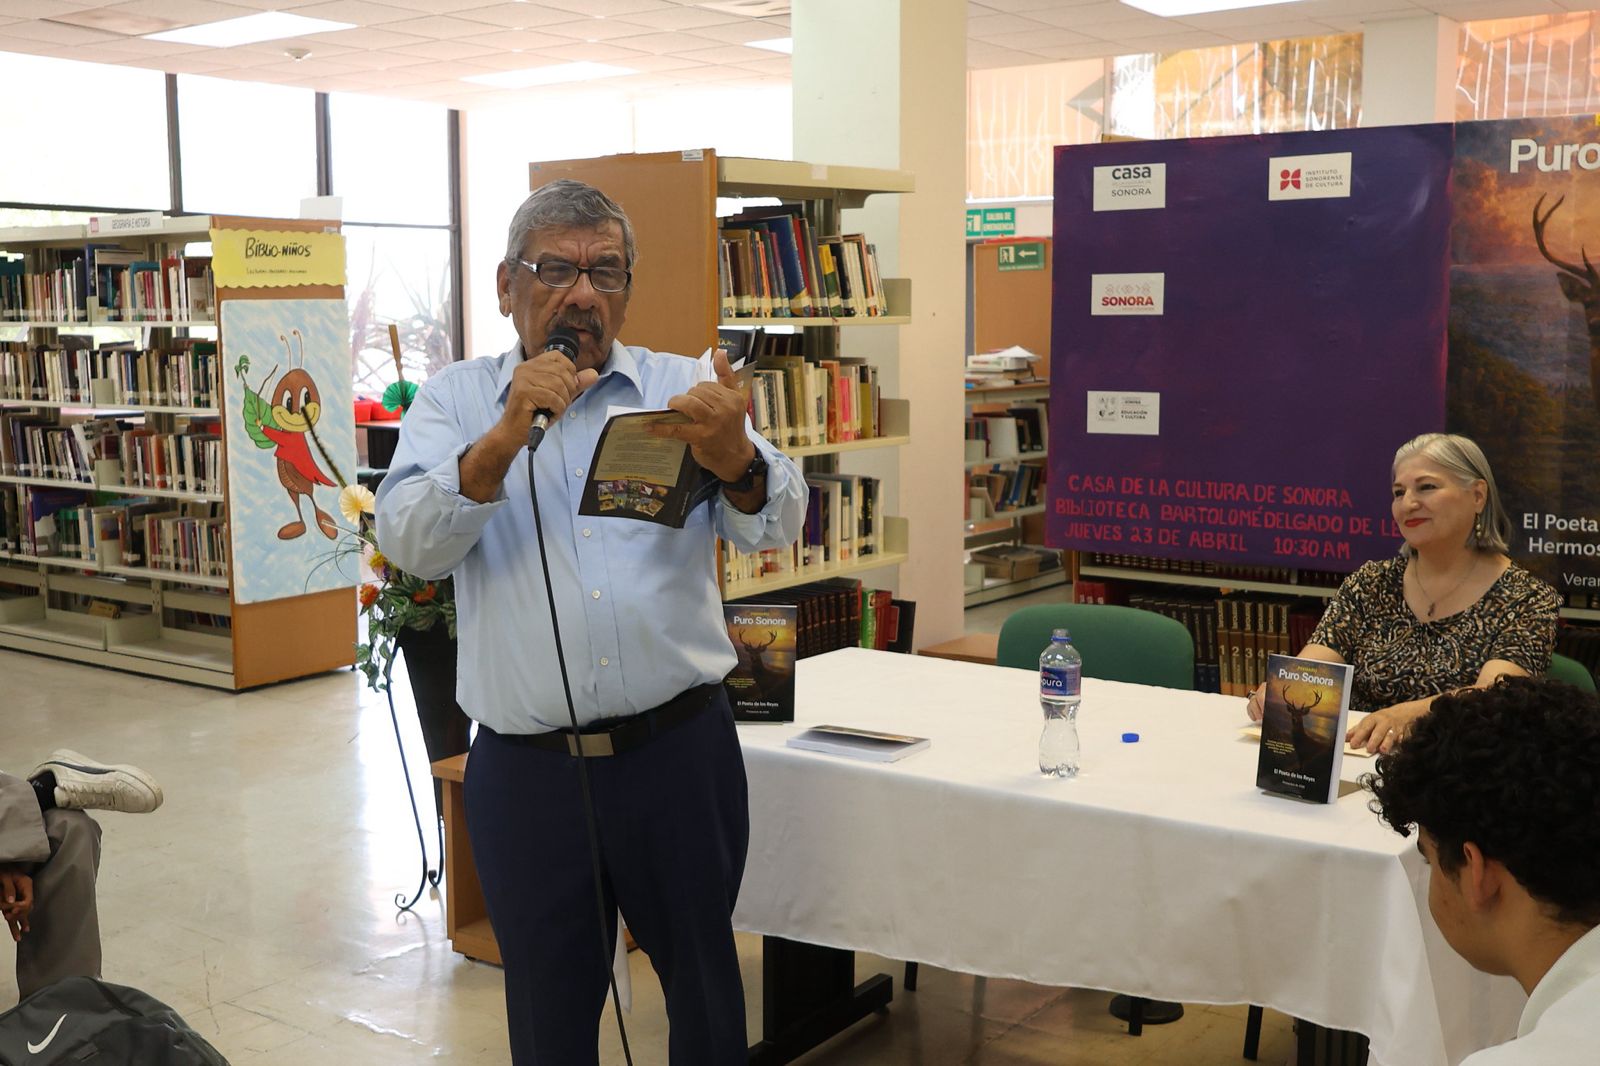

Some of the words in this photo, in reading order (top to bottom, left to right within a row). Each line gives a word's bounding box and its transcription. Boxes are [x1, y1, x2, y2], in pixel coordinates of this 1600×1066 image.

[1510, 138, 1600, 173] Puro
[1112, 166, 1151, 180] casa
[1112, 188, 1151, 197] SONORA
[1102, 296, 1153, 306] SONORA
[1068, 474, 1115, 493] CASA
[1121, 477, 1143, 495] DE
[1150, 479, 1169, 497] LA
[1176, 480, 1250, 501] CULTURA
[1254, 485, 1276, 503] DE
[1283, 486, 1352, 508] SONORA
[1161, 504, 1262, 527] BARTOLOMÉ
[1264, 511, 1343, 533] DELGADO
[1350, 516, 1372, 536] DE
[1523, 513, 1538, 529] El
[1545, 514, 1598, 532] Poeta
[1065, 522, 1122, 541] JUEVES
[1131, 527, 1153, 543] 23
[1159, 528, 1180, 546] DE
[1189, 532, 1248, 551] ABRIL
[1273, 536, 1319, 557] 10:30
[1563, 572, 1600, 587] Vera
[733, 616, 754, 625] Puro
[756, 616, 786, 626] Sonora
[1232, 647, 1239, 656] 2
[1245, 648, 1253, 658] 3
[1258, 649, 1265, 658] 4
[1279, 668, 1299, 682] Puro
[1302, 672, 1334, 687] Sonora
